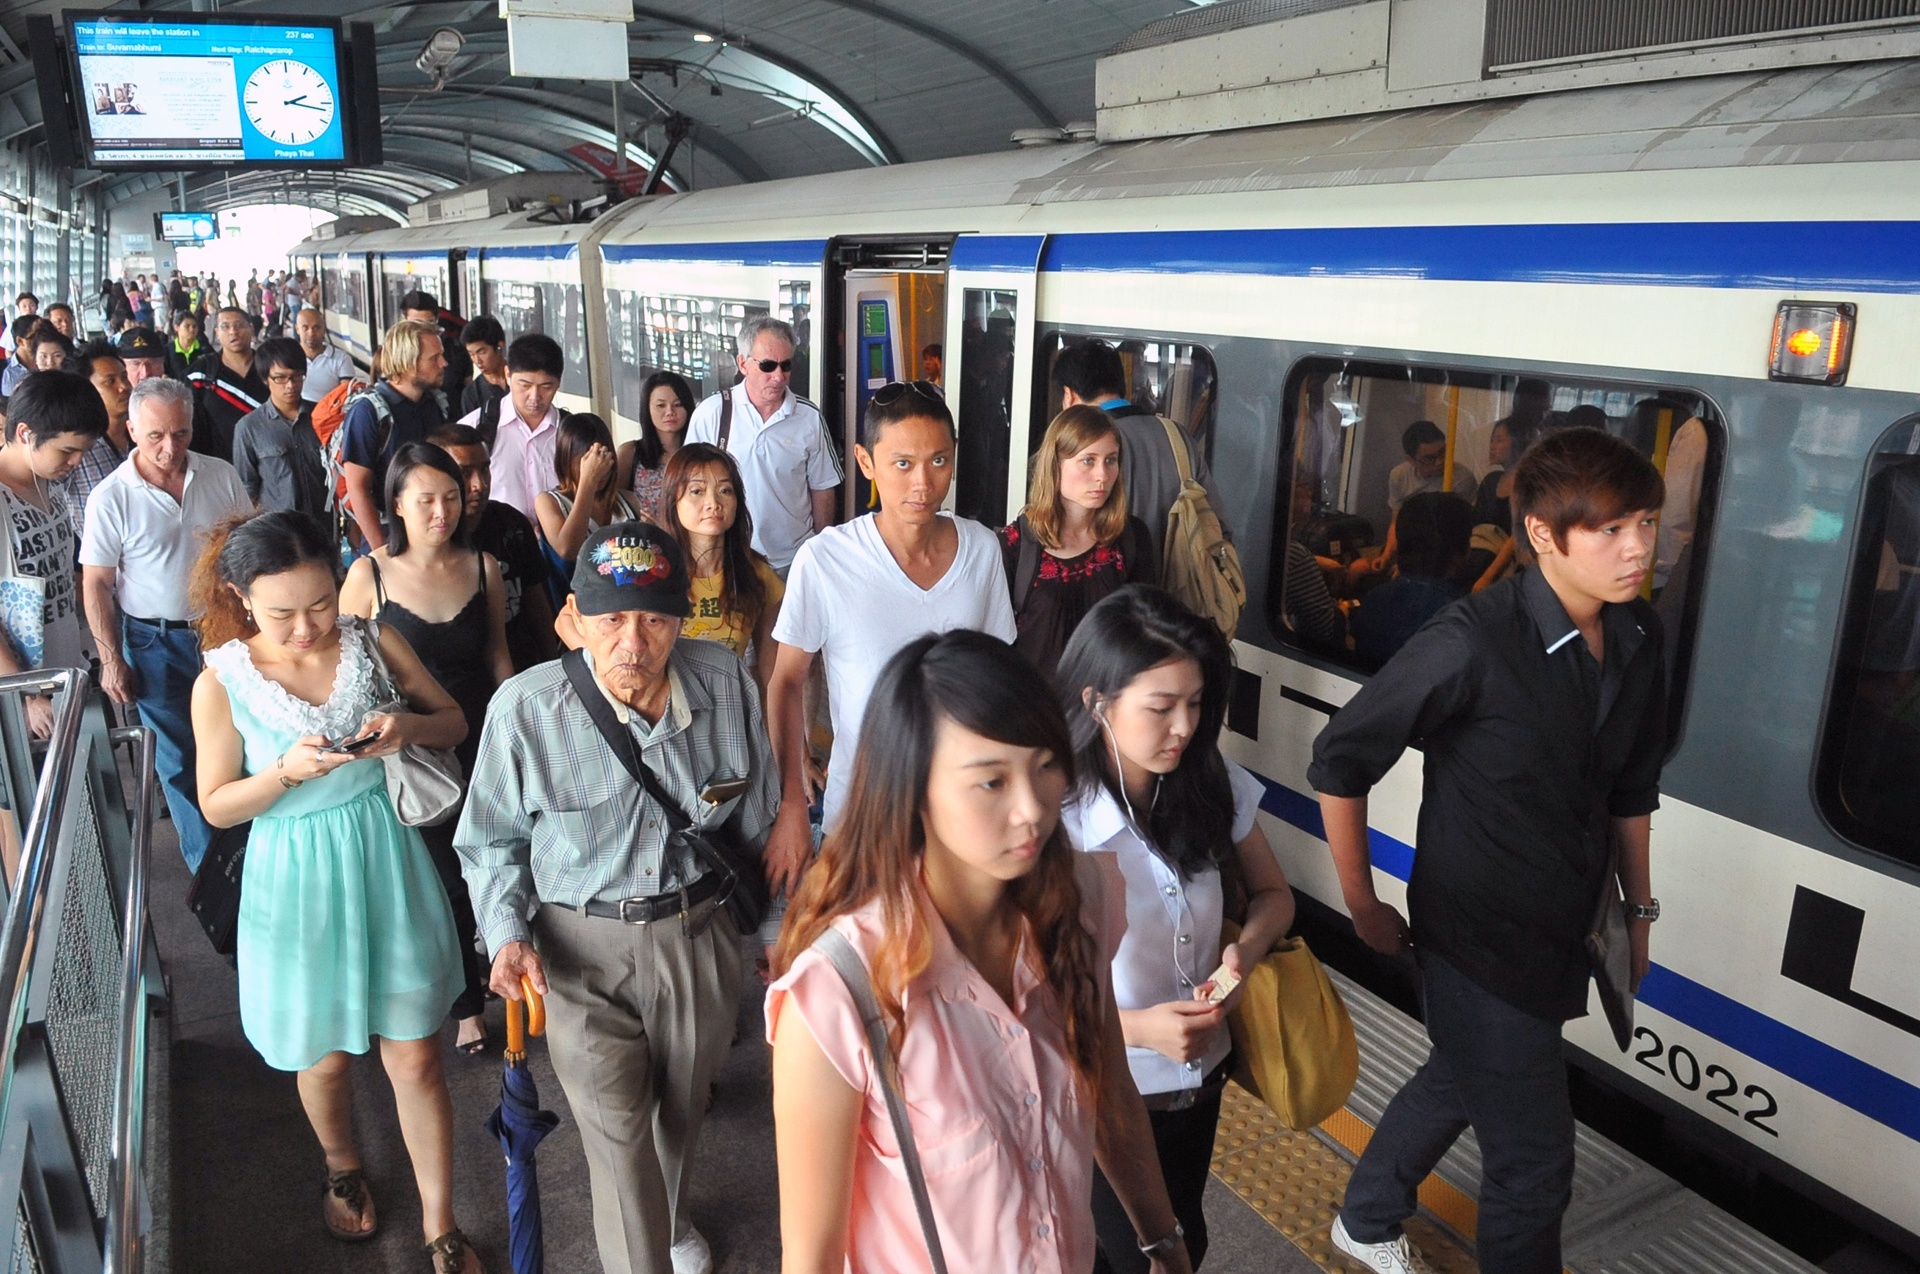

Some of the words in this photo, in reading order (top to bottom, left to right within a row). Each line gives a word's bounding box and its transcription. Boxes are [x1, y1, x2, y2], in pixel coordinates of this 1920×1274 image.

[77, 27, 94, 35] This
[96, 27, 113, 35] train
[129, 28, 150, 36] leave
[151, 28, 164, 36] the
[166, 28, 191, 36] station
[285, 31, 300, 39] 237
[244, 45, 294, 55] Ratchaprarop
[274, 150, 298, 159] Phaya
[615, 536, 652, 549] TEXAS
[611, 545, 657, 569] 2000
[1634, 1026, 1779, 1138] 2022
